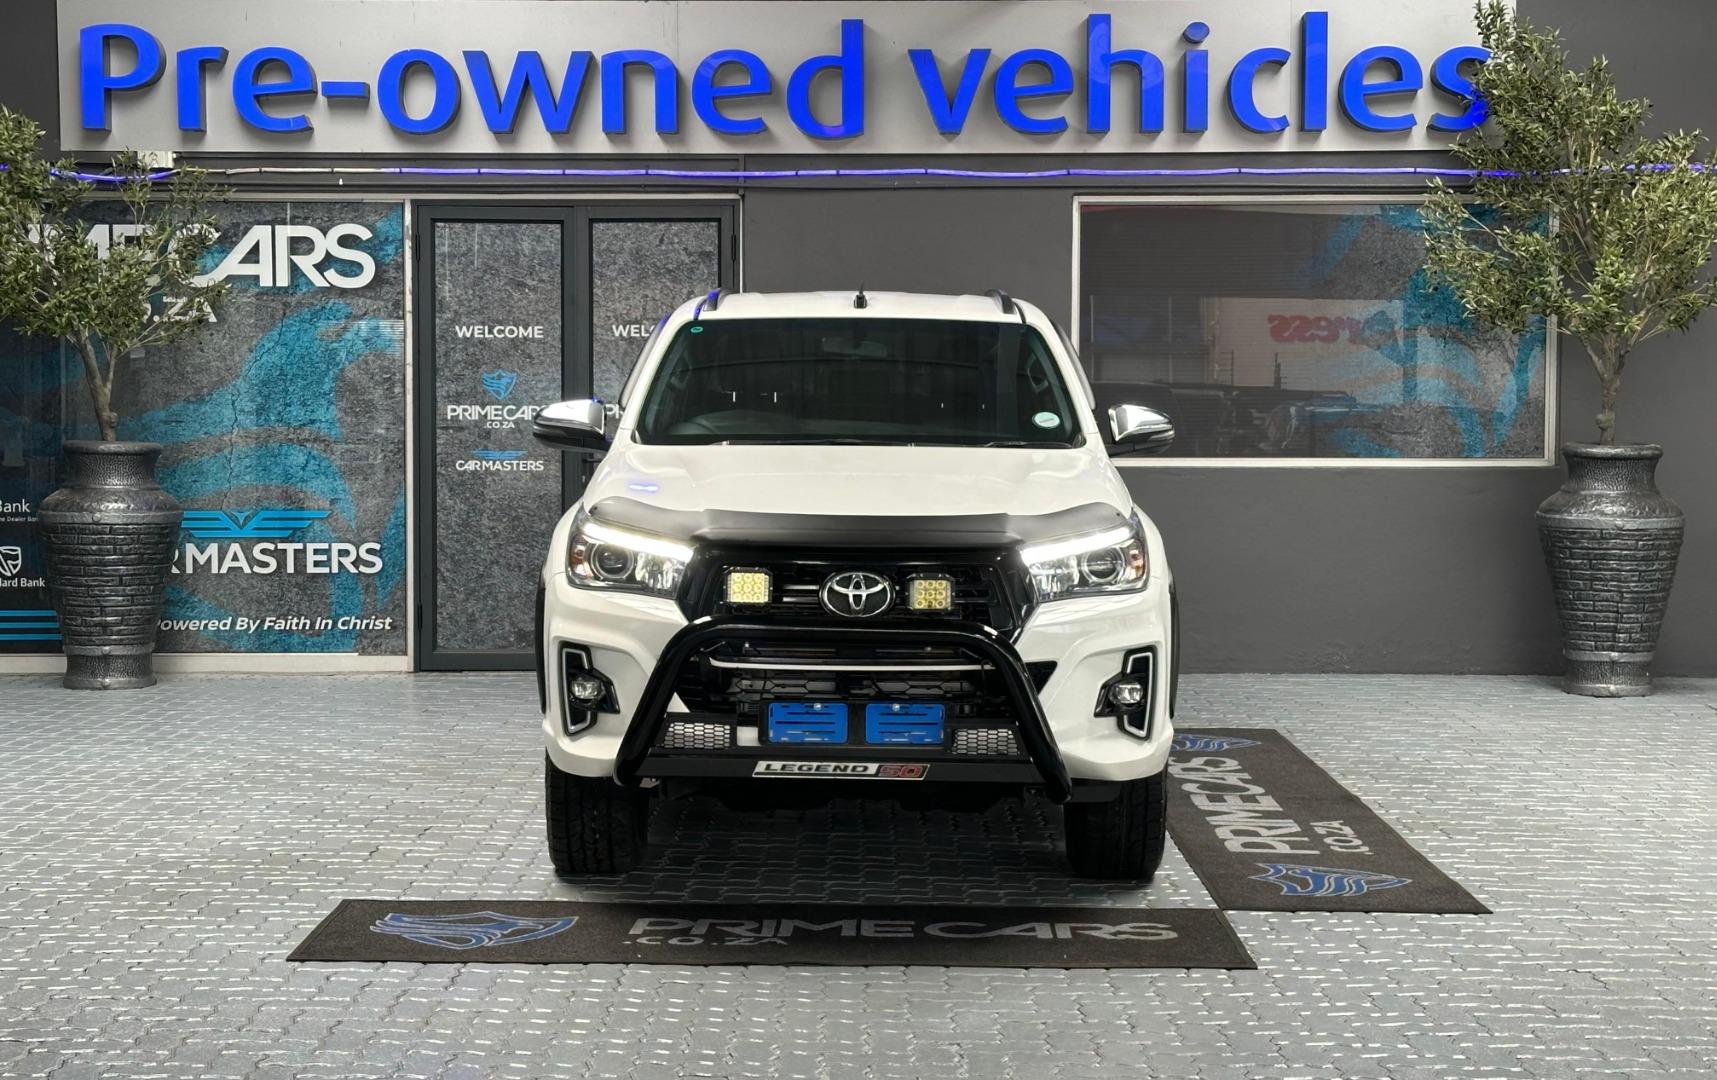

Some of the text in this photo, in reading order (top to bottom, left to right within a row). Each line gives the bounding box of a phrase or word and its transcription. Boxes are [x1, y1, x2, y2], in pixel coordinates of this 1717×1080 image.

[80, 11, 1494, 140] Pre-owned vehicles
[455, 325, 544, 338] WELCOME
[20, 577, 46, 587] Bank
[157, 615, 393, 633] owered By Faith In Christ
[764, 763, 869, 773] LEGEND
